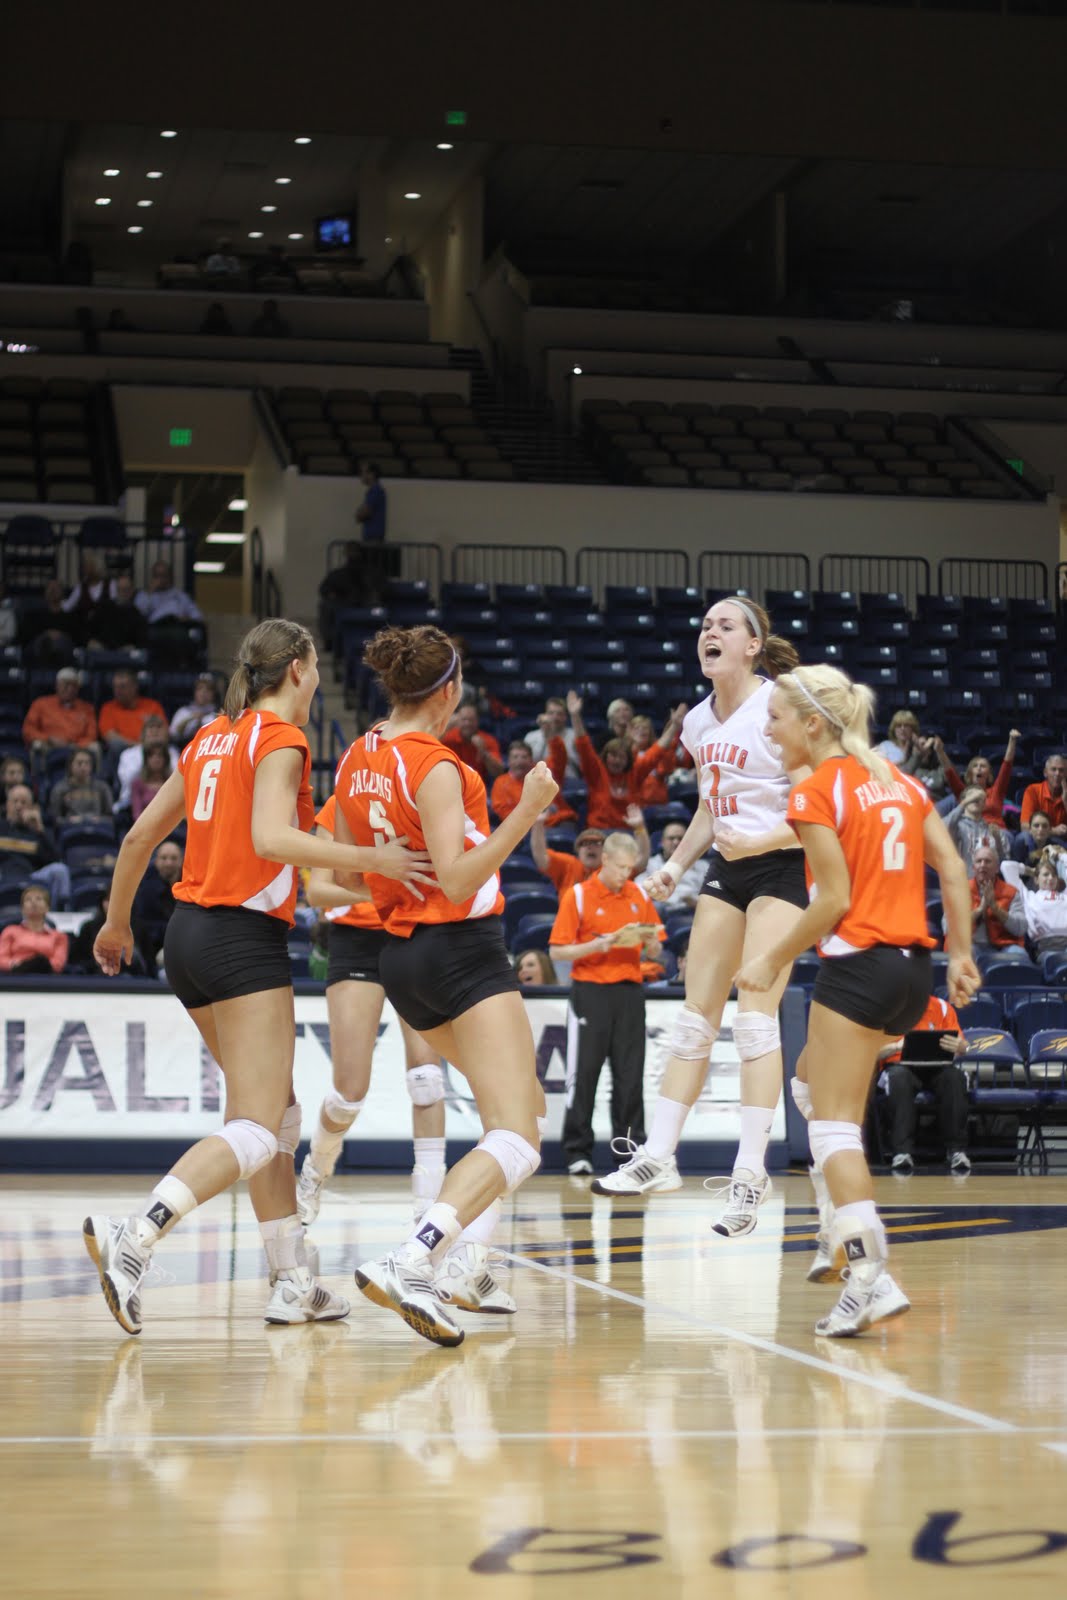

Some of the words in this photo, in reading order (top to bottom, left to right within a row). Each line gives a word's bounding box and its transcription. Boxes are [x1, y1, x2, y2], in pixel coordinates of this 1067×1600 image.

[194, 731, 239, 761] FALCN
[697, 742, 749, 769] WLING
[193, 759, 221, 821] 6
[705, 795, 738, 817] EEN
[881, 806, 905, 871] 2
[0, 1019, 390, 1113] ALI
